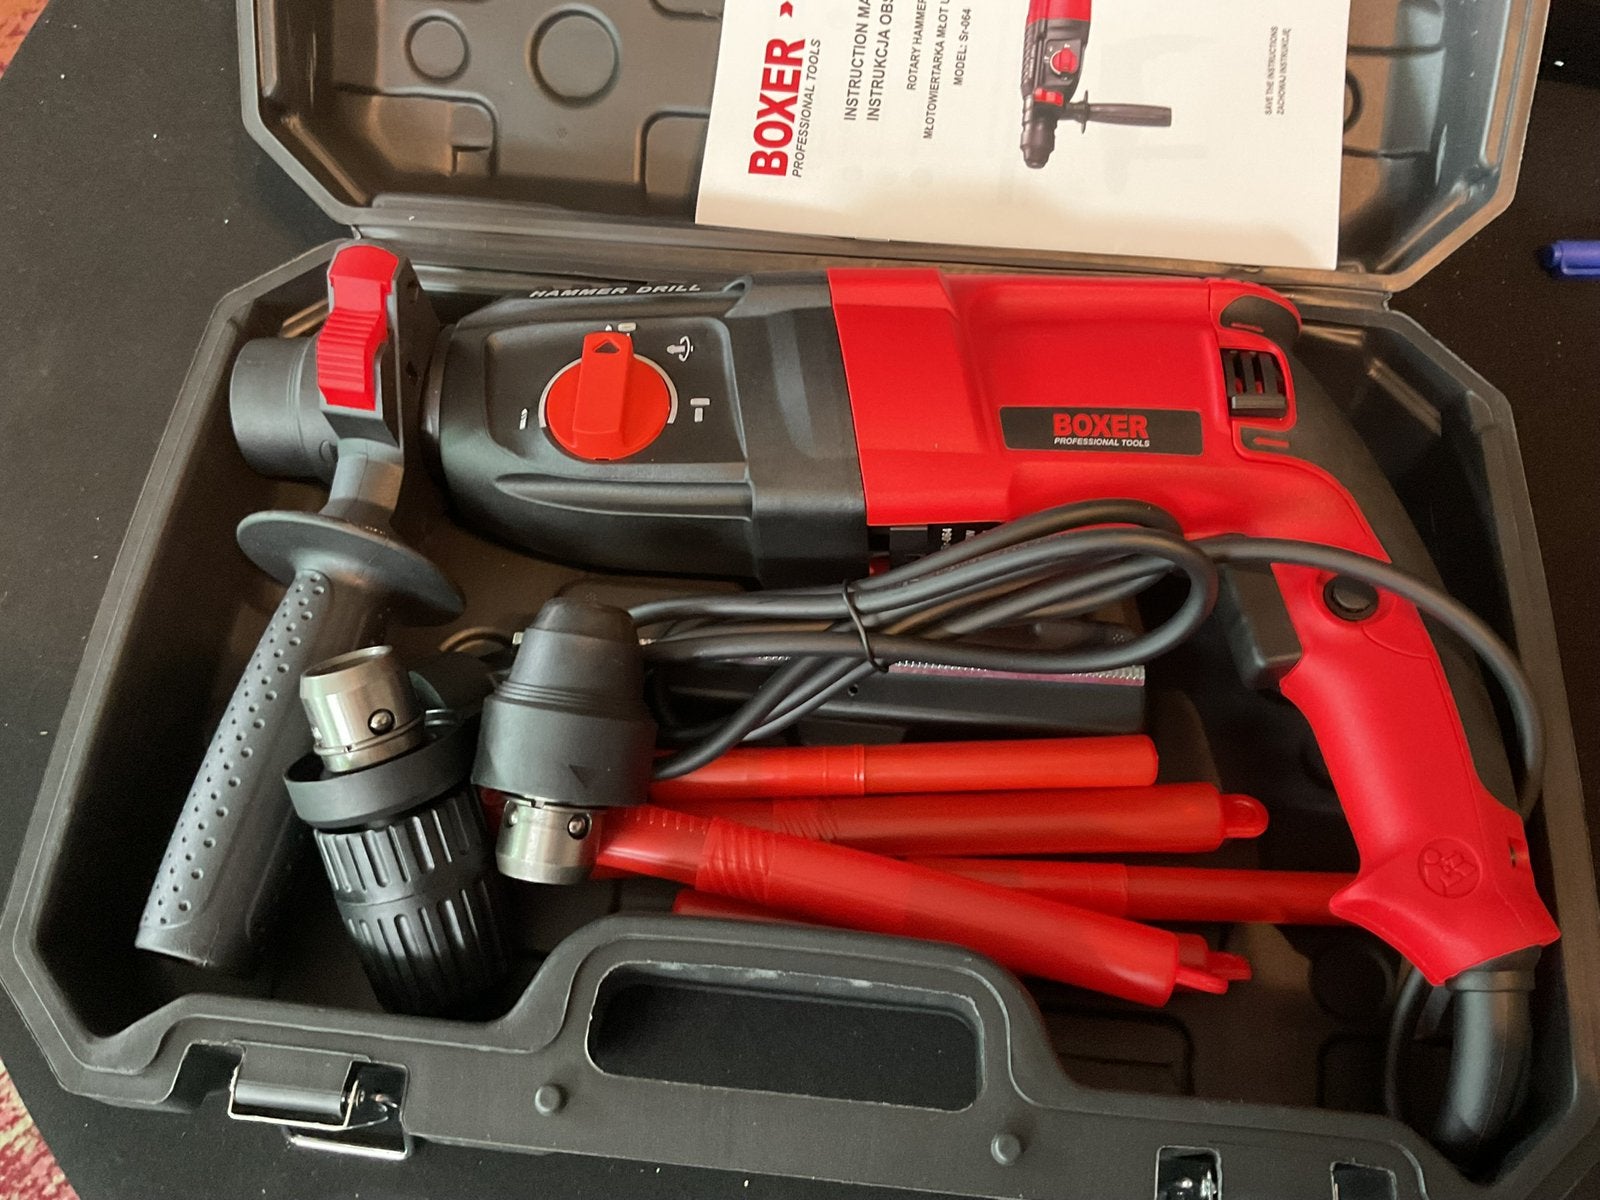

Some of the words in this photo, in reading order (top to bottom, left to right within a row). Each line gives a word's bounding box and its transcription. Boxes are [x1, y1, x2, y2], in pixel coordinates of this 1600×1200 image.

[958, 8, 973, 42] Sr-064
[843, 22, 869, 121] INSTRUCTION
[906, 46, 922, 90] ROTARY
[923, 40, 946, 139] MŁOTOWIERTARKA
[936, 6, 949, 38] MŁOT
[953, 44, 968, 86] MODEL:
[1267, 26, 1279, 80] INSTRUCTIONS
[867, 29, 891, 121] INSTRUKCJA
[1265, 81, 1274, 95] THE
[748, 38, 806, 176] BOXER
[792, 84, 816, 178] PROFESSIONAL
[806, 38, 821, 81] TOOLS
[1264, 97, 1273, 115] SAVE
[529, 286, 628, 298] HAMMER
[636, 284, 701, 294] DRILL
[1053, 413, 1149, 438] BOXER
[1054, 437, 1120, 447] PROFESSIONAL
[1122, 439, 1150, 448] TOOLS
